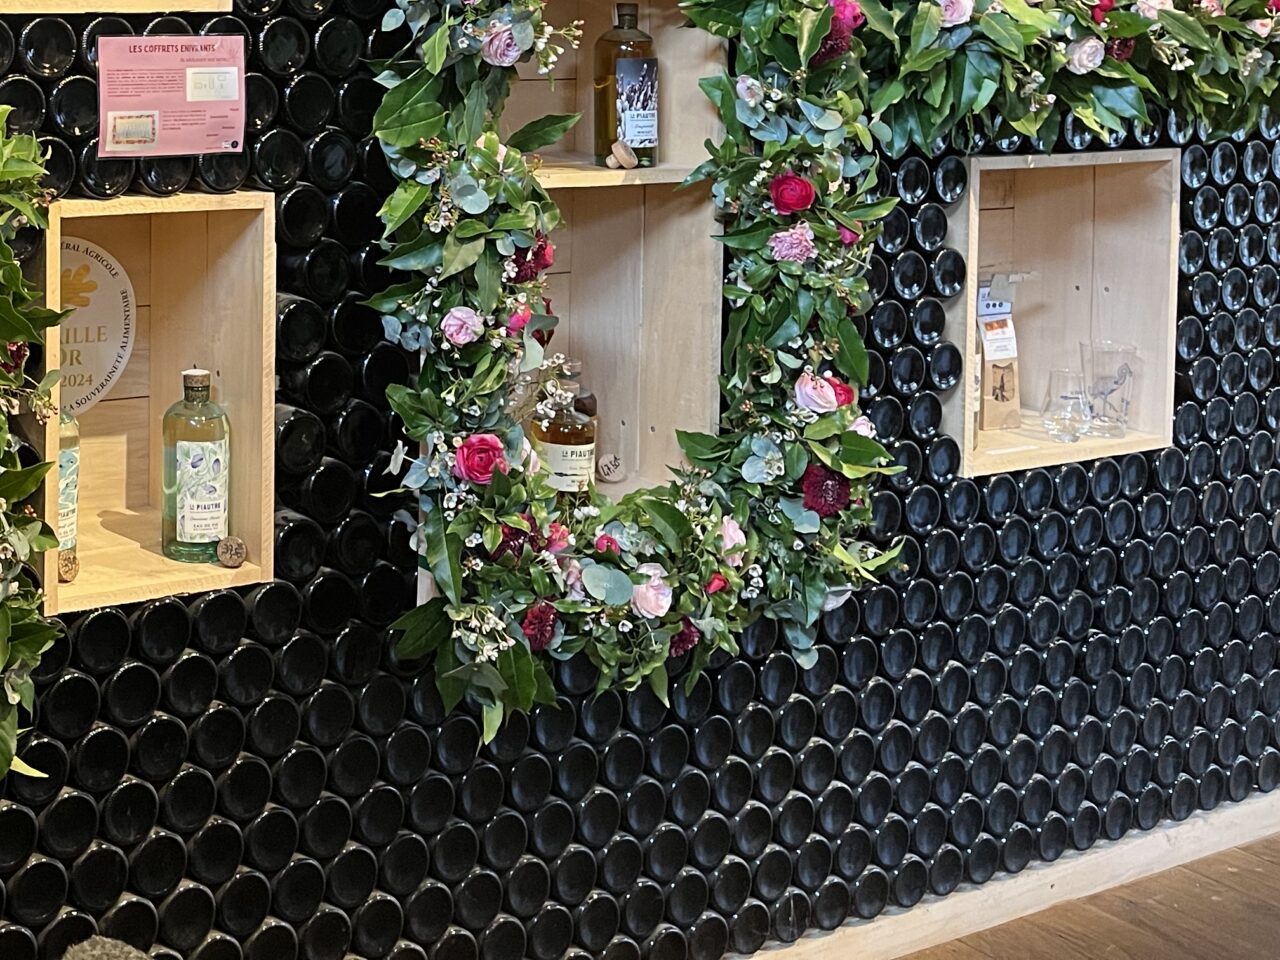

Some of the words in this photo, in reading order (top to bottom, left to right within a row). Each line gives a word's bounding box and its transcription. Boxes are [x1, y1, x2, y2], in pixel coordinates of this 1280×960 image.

[129, 45, 142, 53] LES
[144, 44, 179, 53] COFFRETS
[81, 247, 119, 279] AGRICOLE
[75, 352, 124, 409] SOUVERAINETÉ
[119, 289, 132, 352] ALIMENTAIRE
[60, 373, 93, 387] 2024
